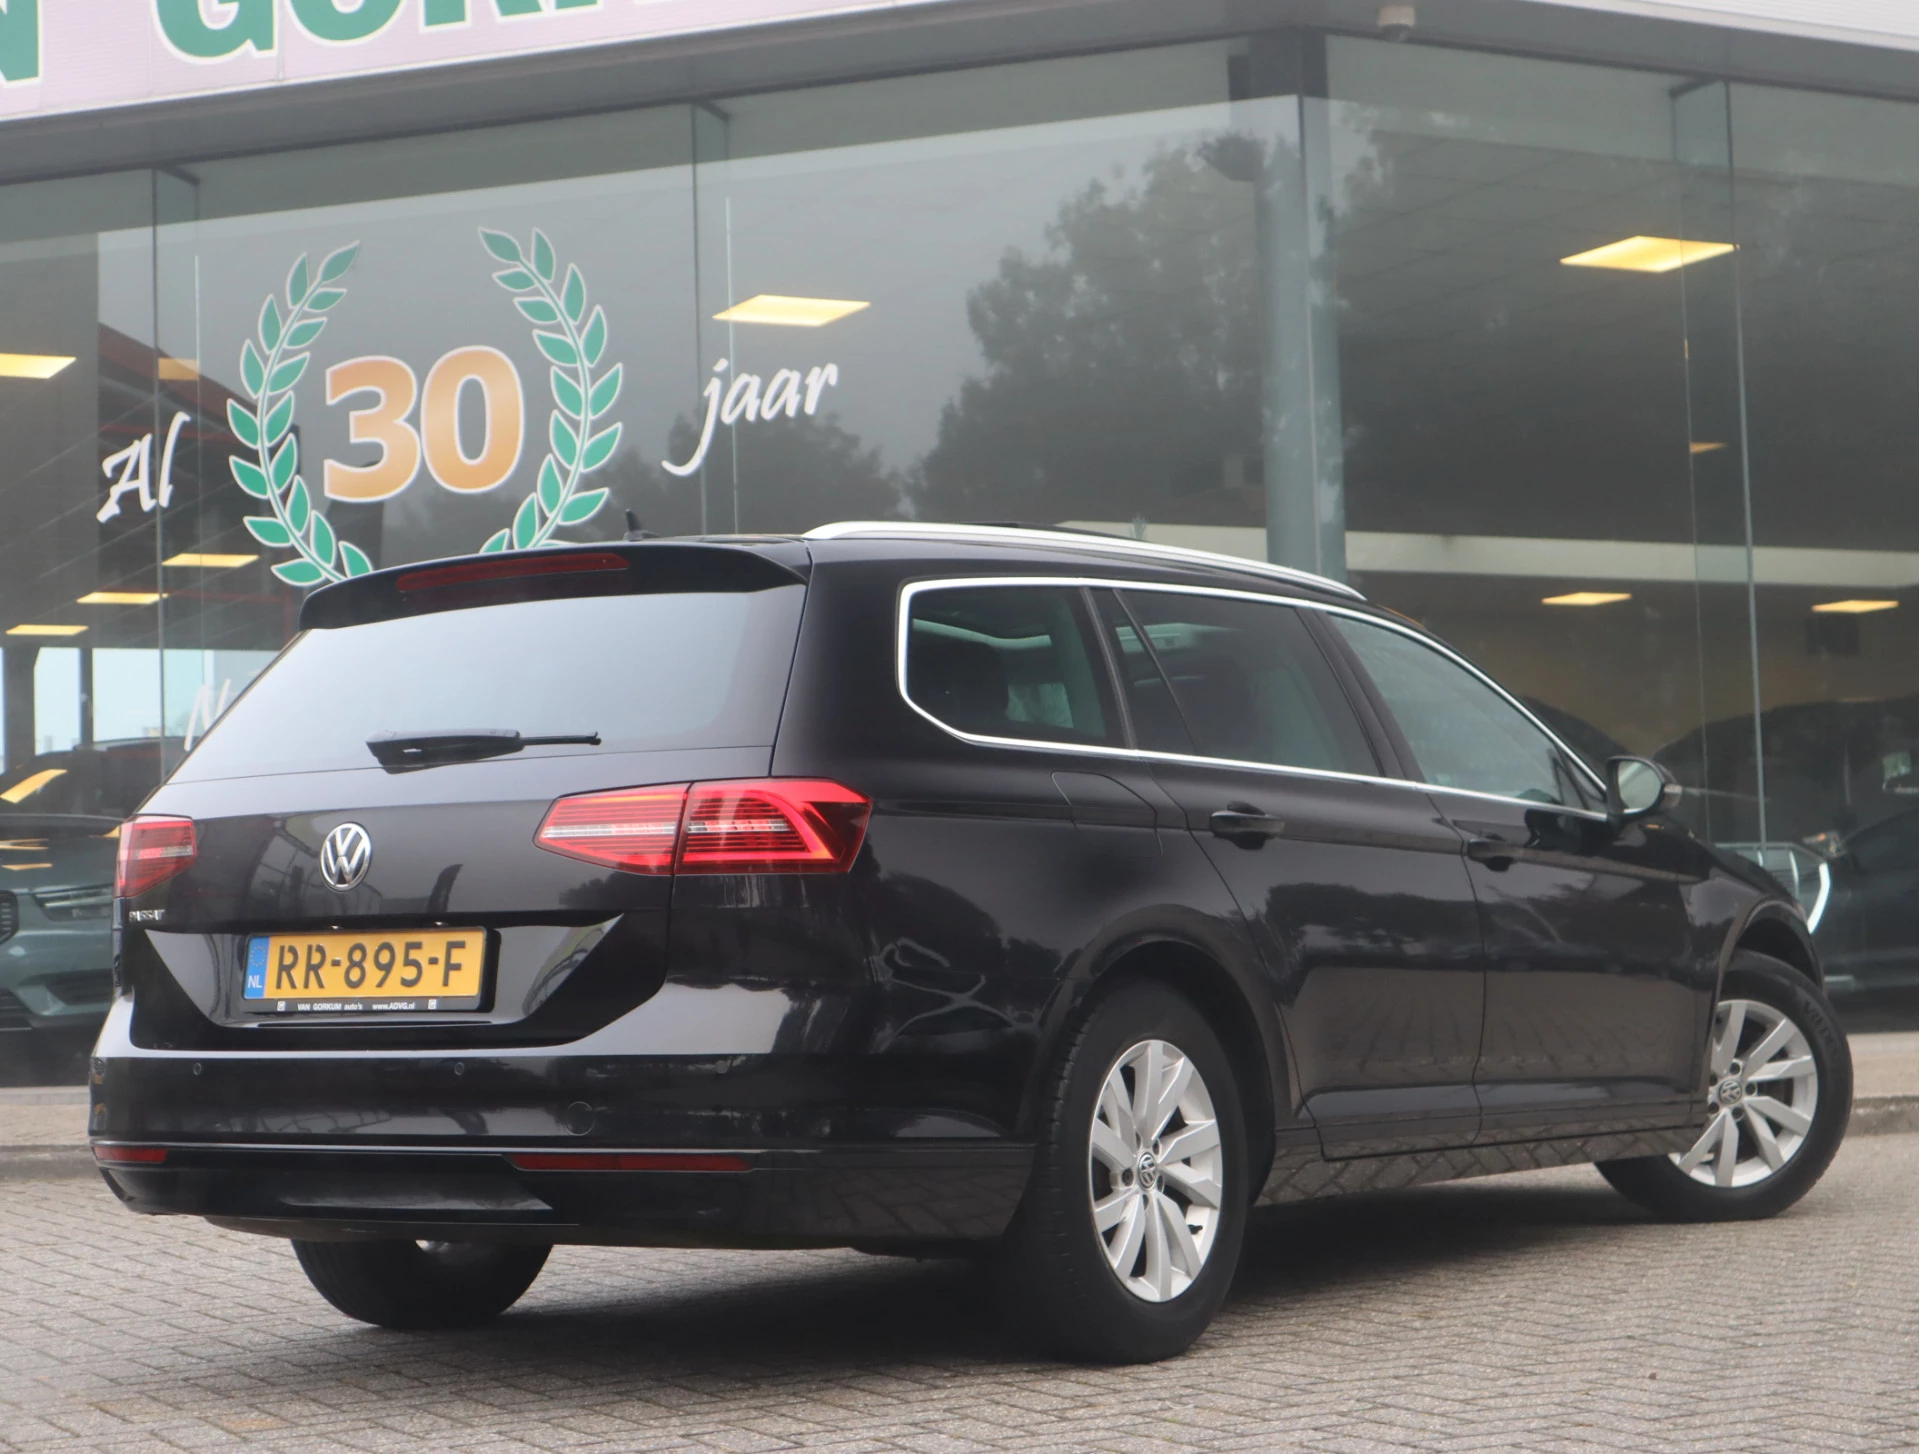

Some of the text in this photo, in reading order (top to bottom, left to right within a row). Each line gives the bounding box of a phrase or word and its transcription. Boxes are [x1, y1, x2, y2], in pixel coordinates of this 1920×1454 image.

[96, 345, 838, 523] Al 30 jaar
[275, 940, 467, 990] RR-895-F
[247, 975, 263, 989] NL
[297, 1003, 311, 1011] VAN
[312, 1002, 342, 1011] GORKUM
[344, 1002, 363, 1011] auto's
[372, 1001, 416, 1011] www.ADVG.nl
